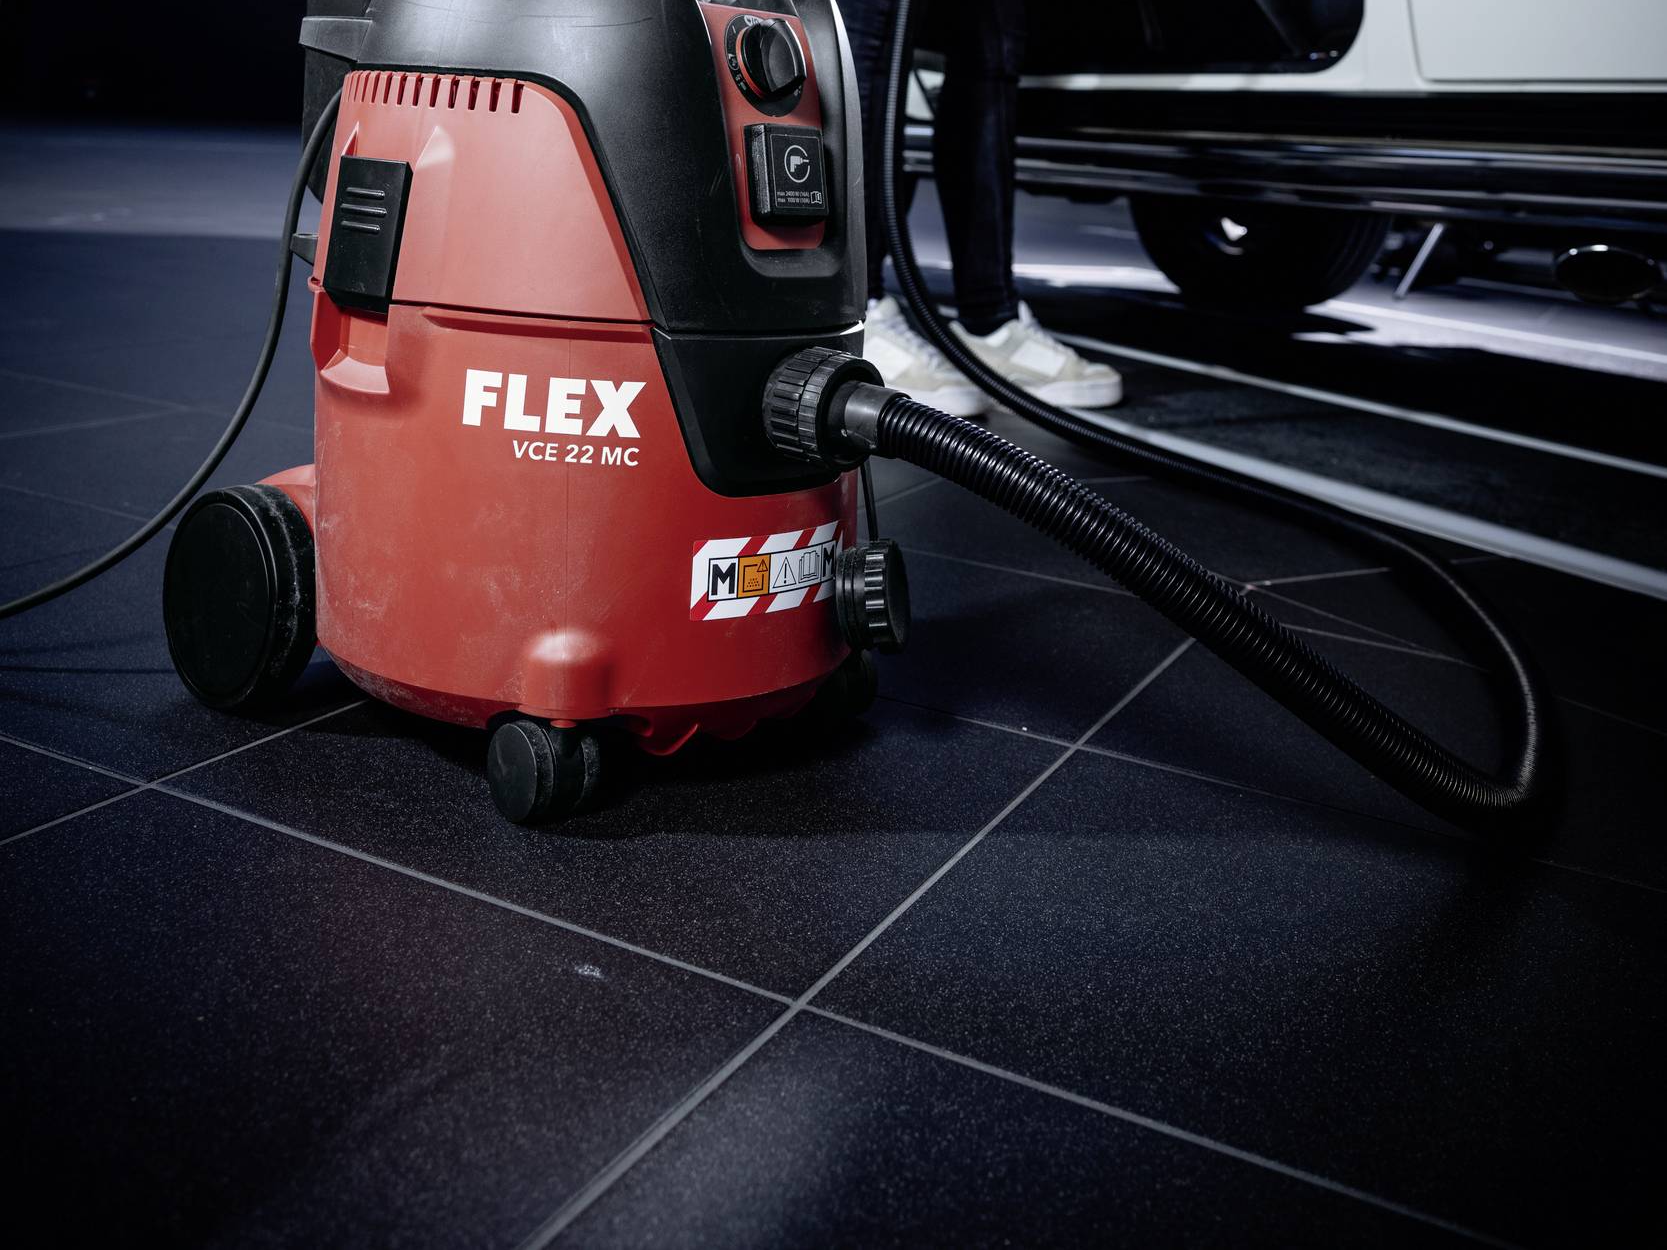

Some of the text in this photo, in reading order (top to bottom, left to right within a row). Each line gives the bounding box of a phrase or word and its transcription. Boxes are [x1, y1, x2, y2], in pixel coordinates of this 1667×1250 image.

[462, 368, 647, 438] FLEX
[512, 440, 640, 467] VCE 22 MC
[823, 544, 835, 577] M
[711, 562, 736, 596] M
